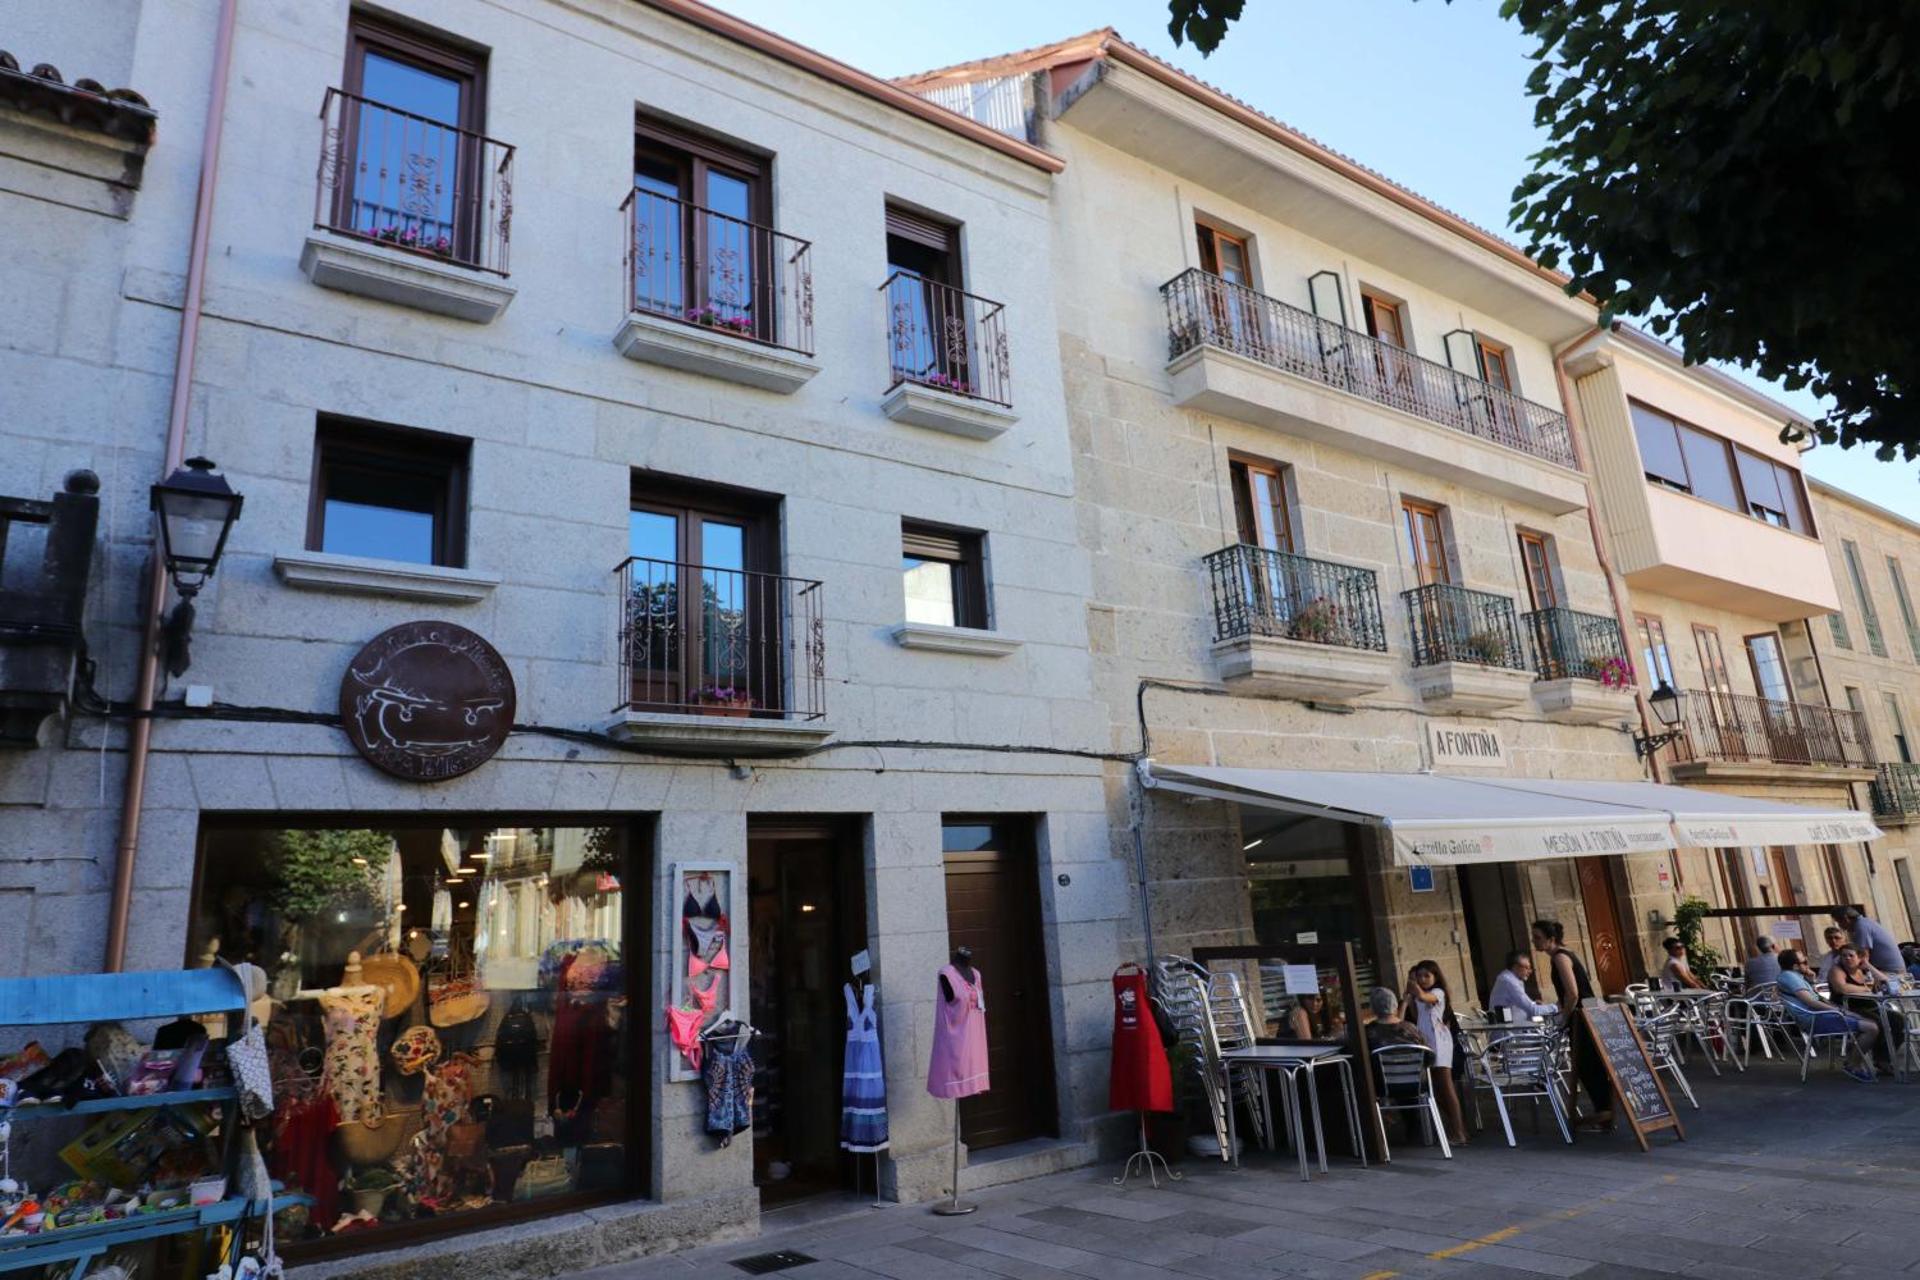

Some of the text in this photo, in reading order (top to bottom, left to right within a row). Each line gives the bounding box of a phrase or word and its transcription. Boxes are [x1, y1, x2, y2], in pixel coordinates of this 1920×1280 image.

[1436, 728, 1501, 757] A FONTIÑA
[1448, 839, 1482, 855] Galicia
[1542, 831, 1583, 854] MESÓN
[1589, 827, 1628, 851] FONTIÑA
